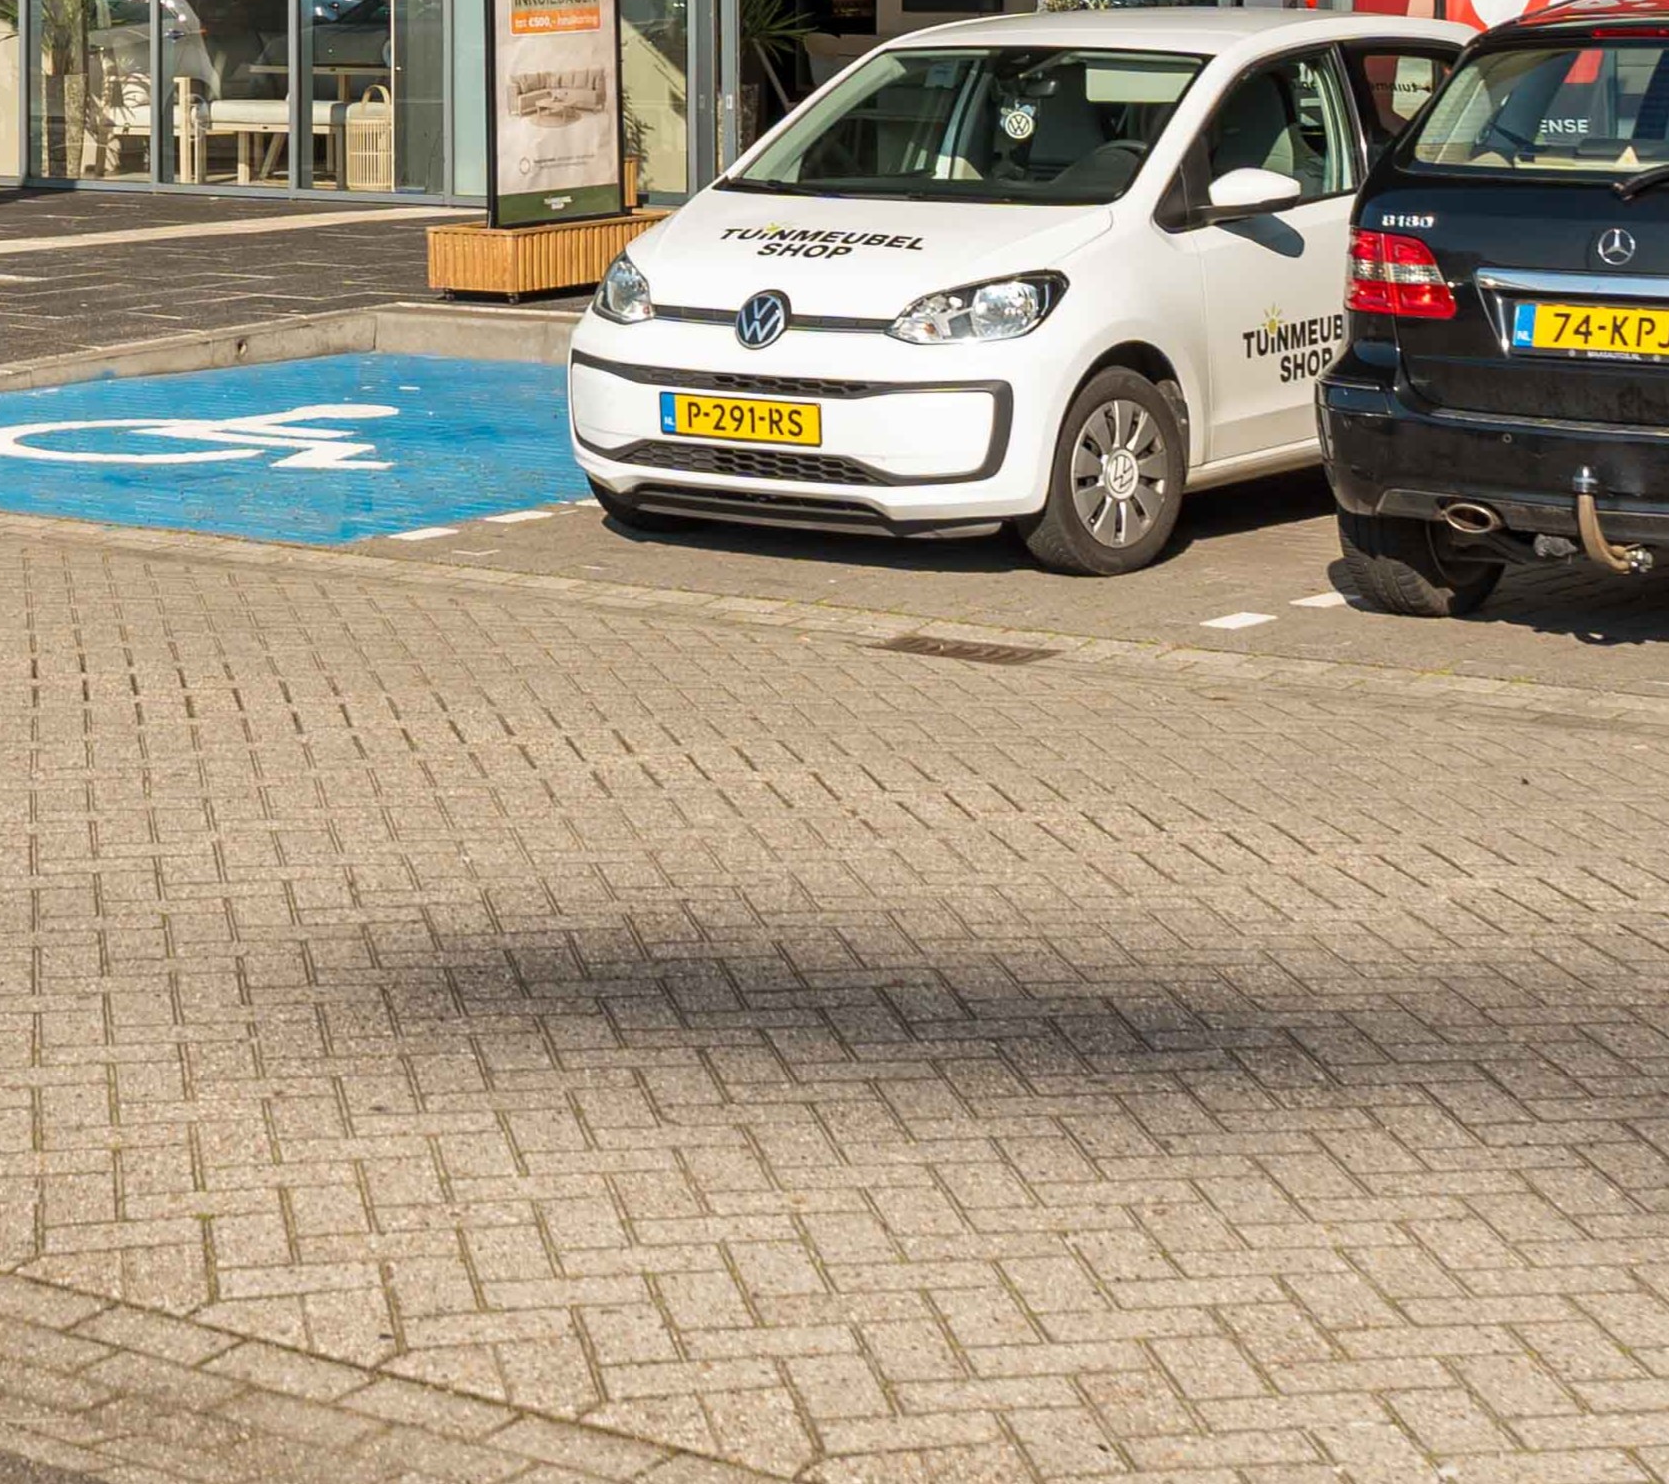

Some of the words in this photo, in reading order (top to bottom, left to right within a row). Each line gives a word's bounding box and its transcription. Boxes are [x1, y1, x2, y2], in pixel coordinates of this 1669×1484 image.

[1540, 119, 1589, 134] ENSE
[756, 242, 853, 259] SHOP
[1280, 347, 1333, 383] SHOP
[686, 401, 804, 437] P-291-RS
